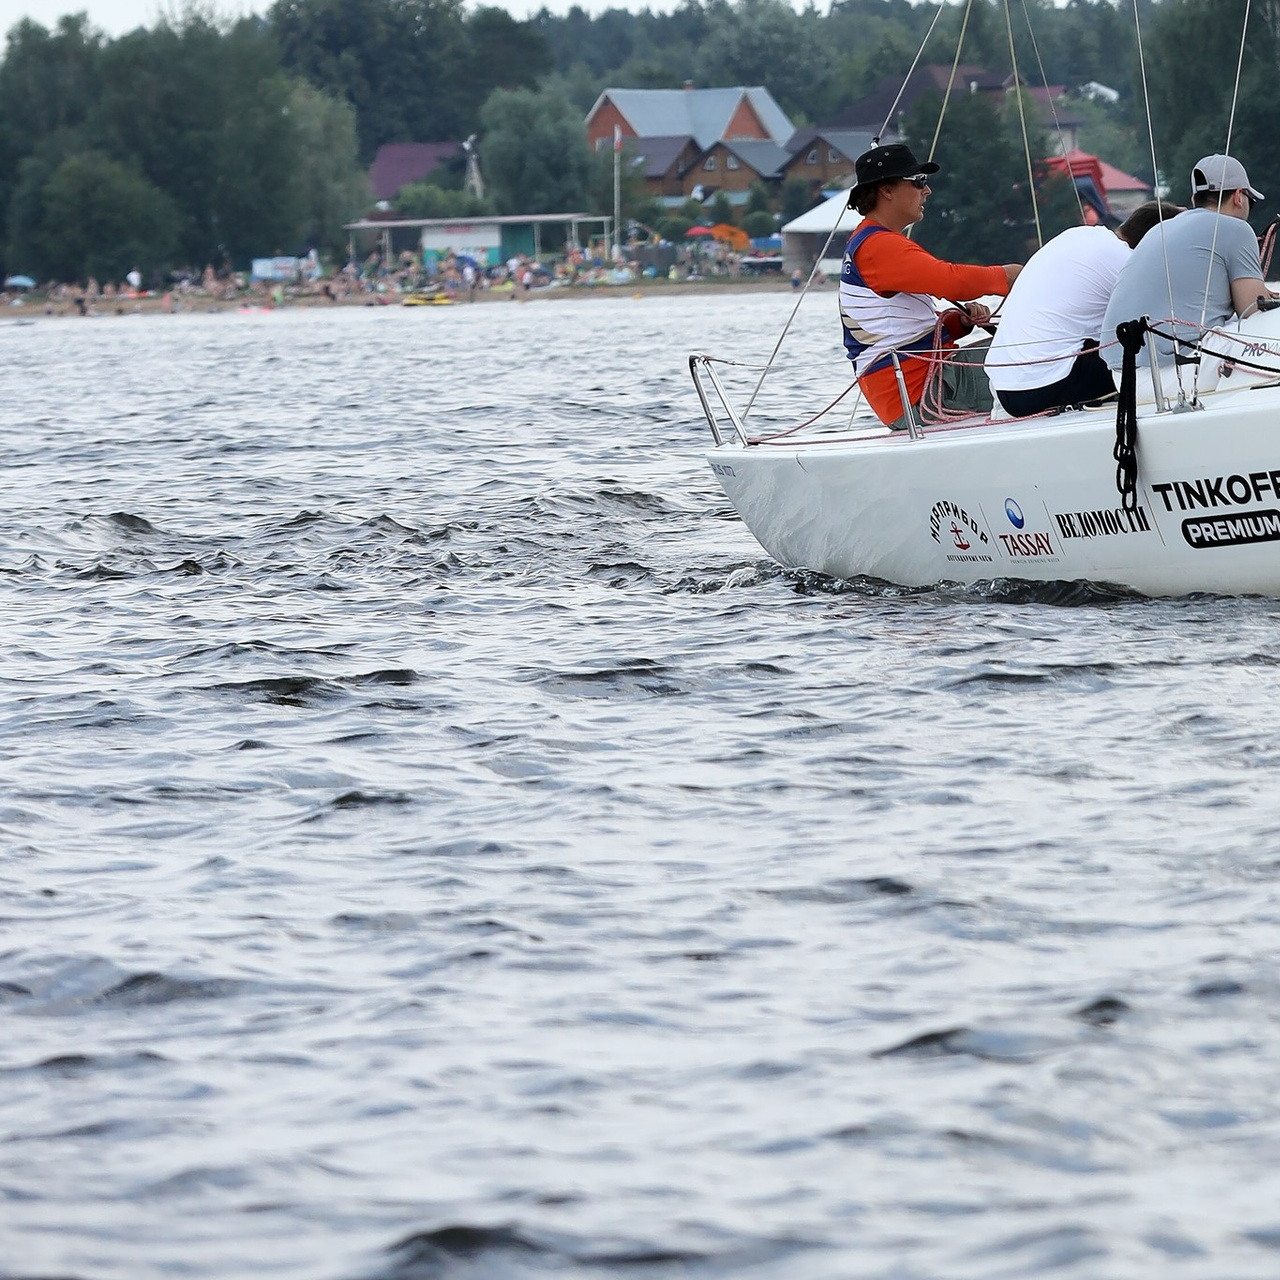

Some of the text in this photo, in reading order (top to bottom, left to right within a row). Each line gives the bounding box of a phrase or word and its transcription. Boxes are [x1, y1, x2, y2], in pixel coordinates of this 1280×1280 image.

[929, 500, 989, 544] МОРПРИБОР
[1055, 506, 1151, 540] ВЕДОМОСТИ
[999, 532, 1055, 557] TASSAY
